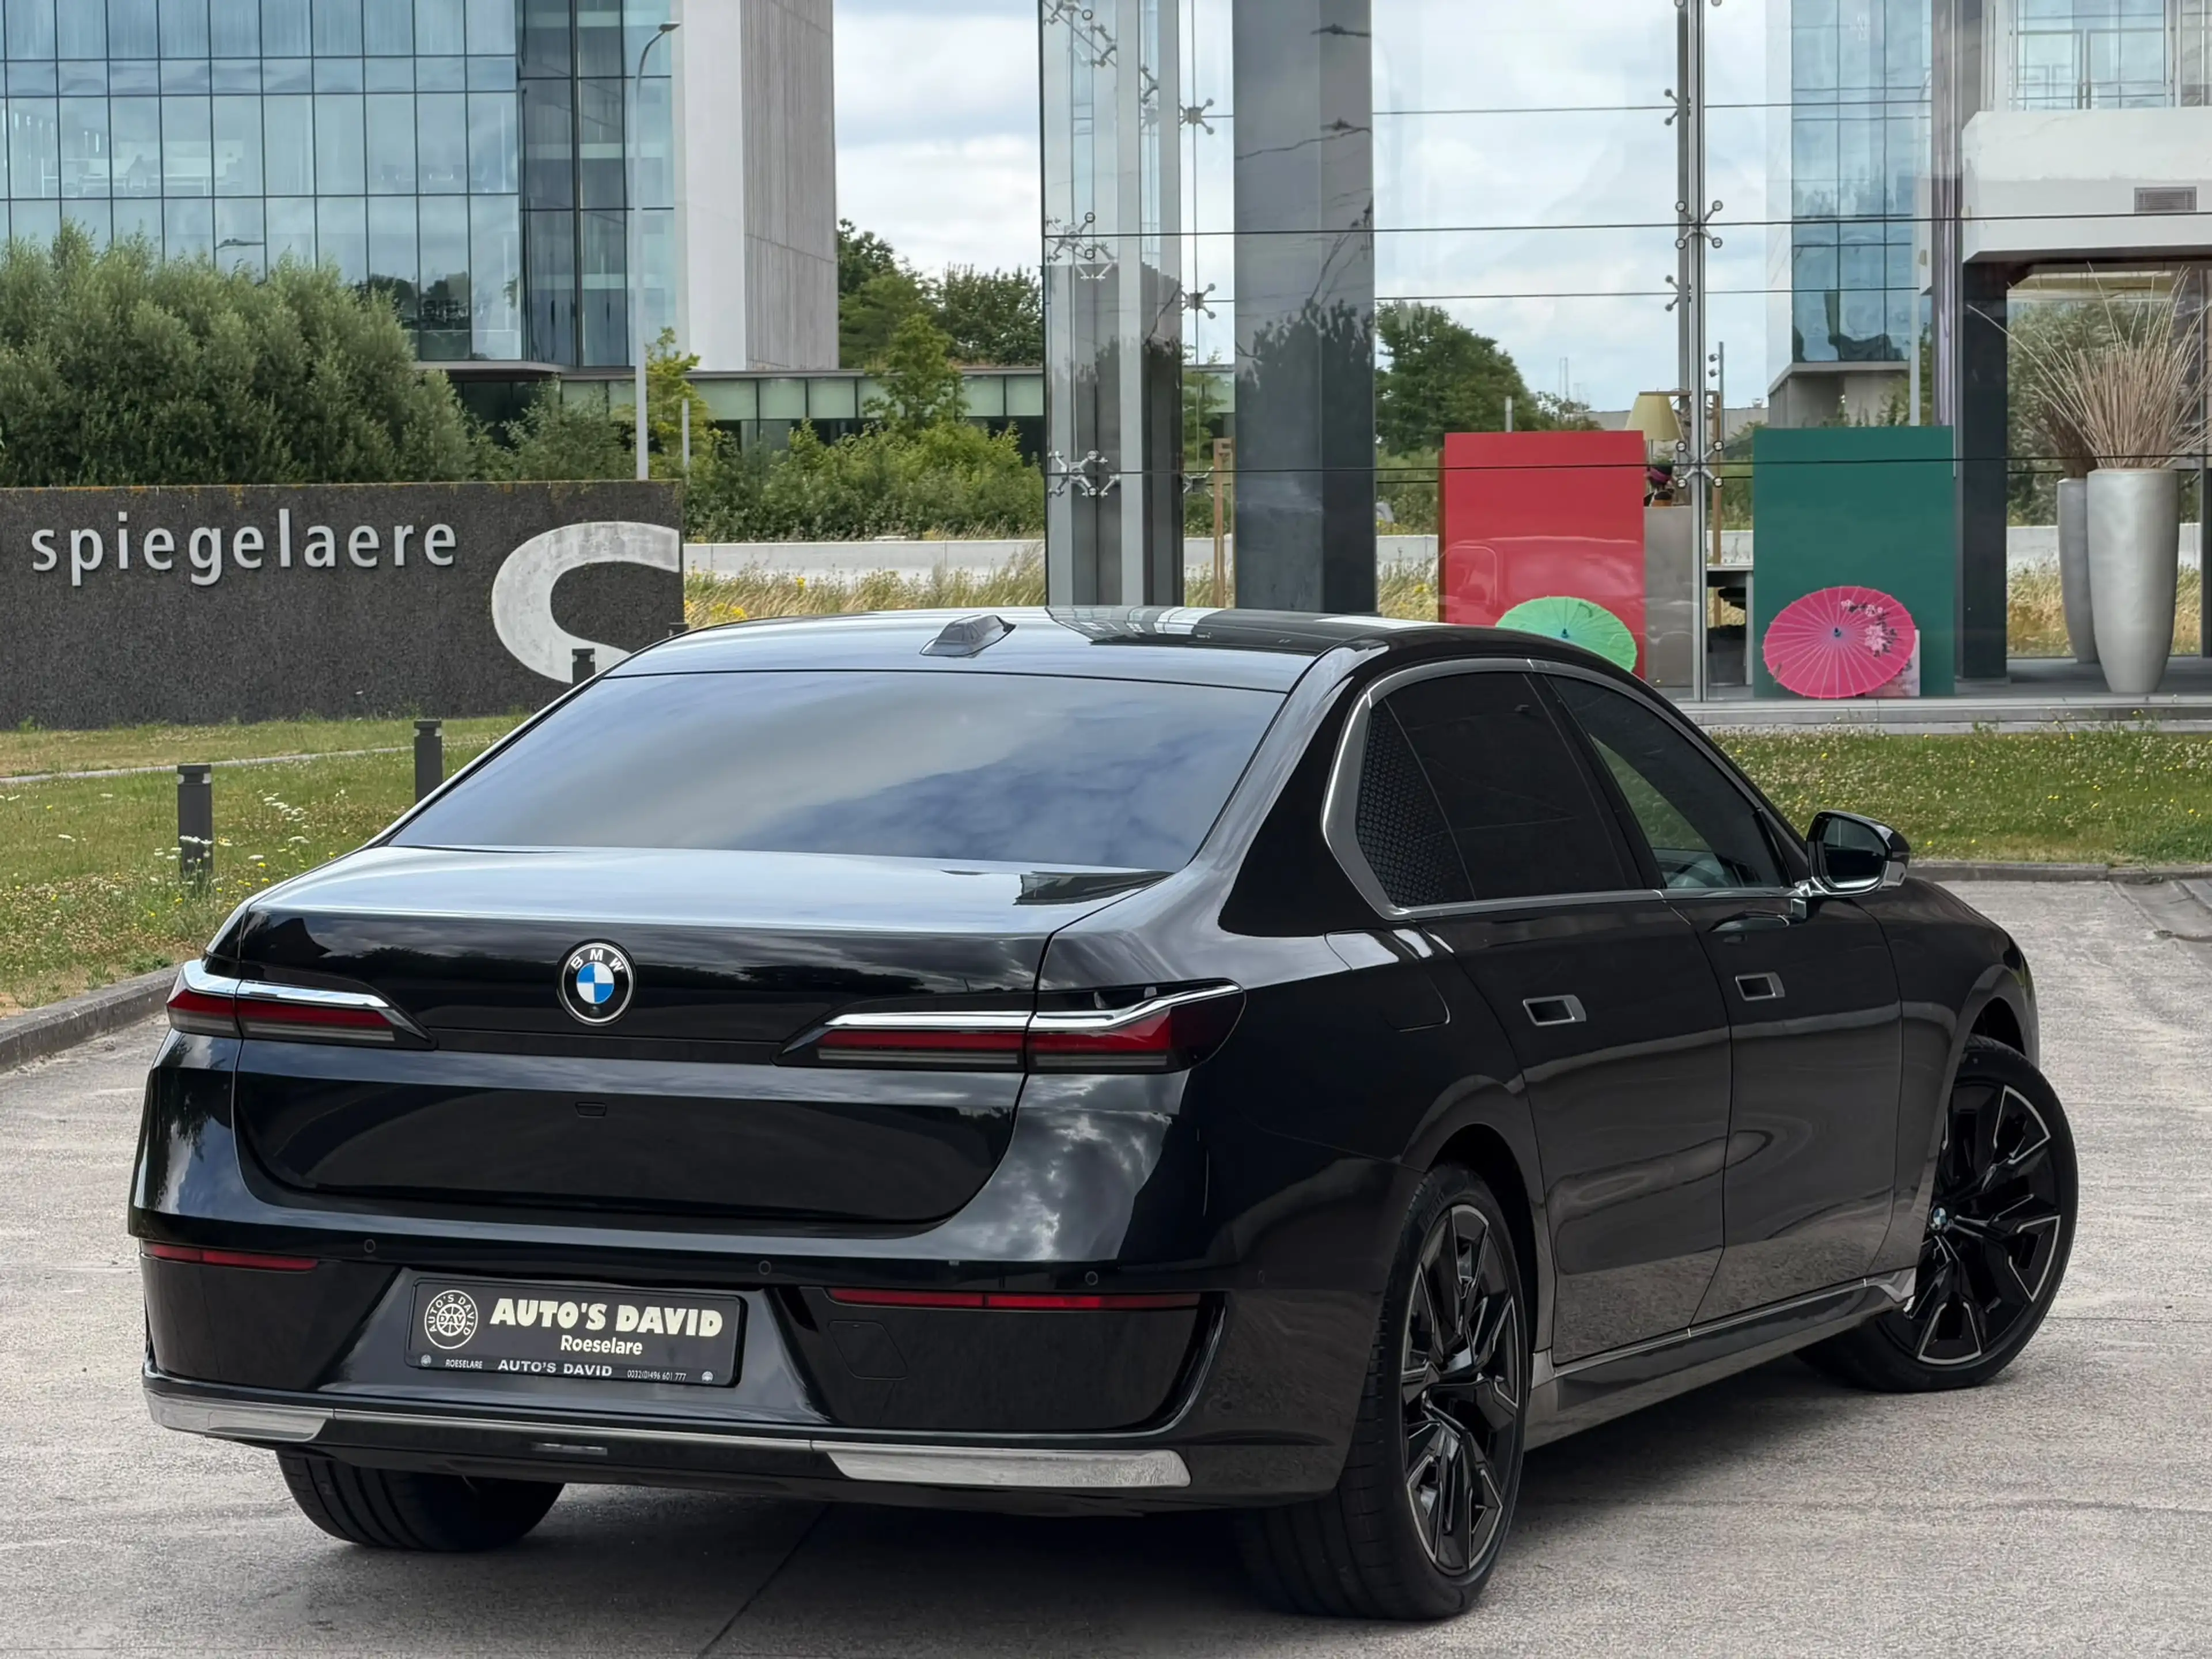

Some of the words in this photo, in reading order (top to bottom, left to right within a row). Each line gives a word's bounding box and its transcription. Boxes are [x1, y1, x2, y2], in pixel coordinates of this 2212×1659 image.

[31, 508, 457, 586] spiegelaere
[570, 949, 624, 972] BMW
[428, 1294, 454, 1332] AUTO'S
[457, 1296, 475, 1336] DAVID
[490, 1298, 607, 1331] AUTO'S
[615, 1305, 723, 1337] DAVID
[560, 1335, 643, 1355] Roeselare
[445, 1359, 483, 1369] ROESELARE
[498, 1359, 557, 1374] AUTO'S
[563, 1363, 612, 1377] DAVID
